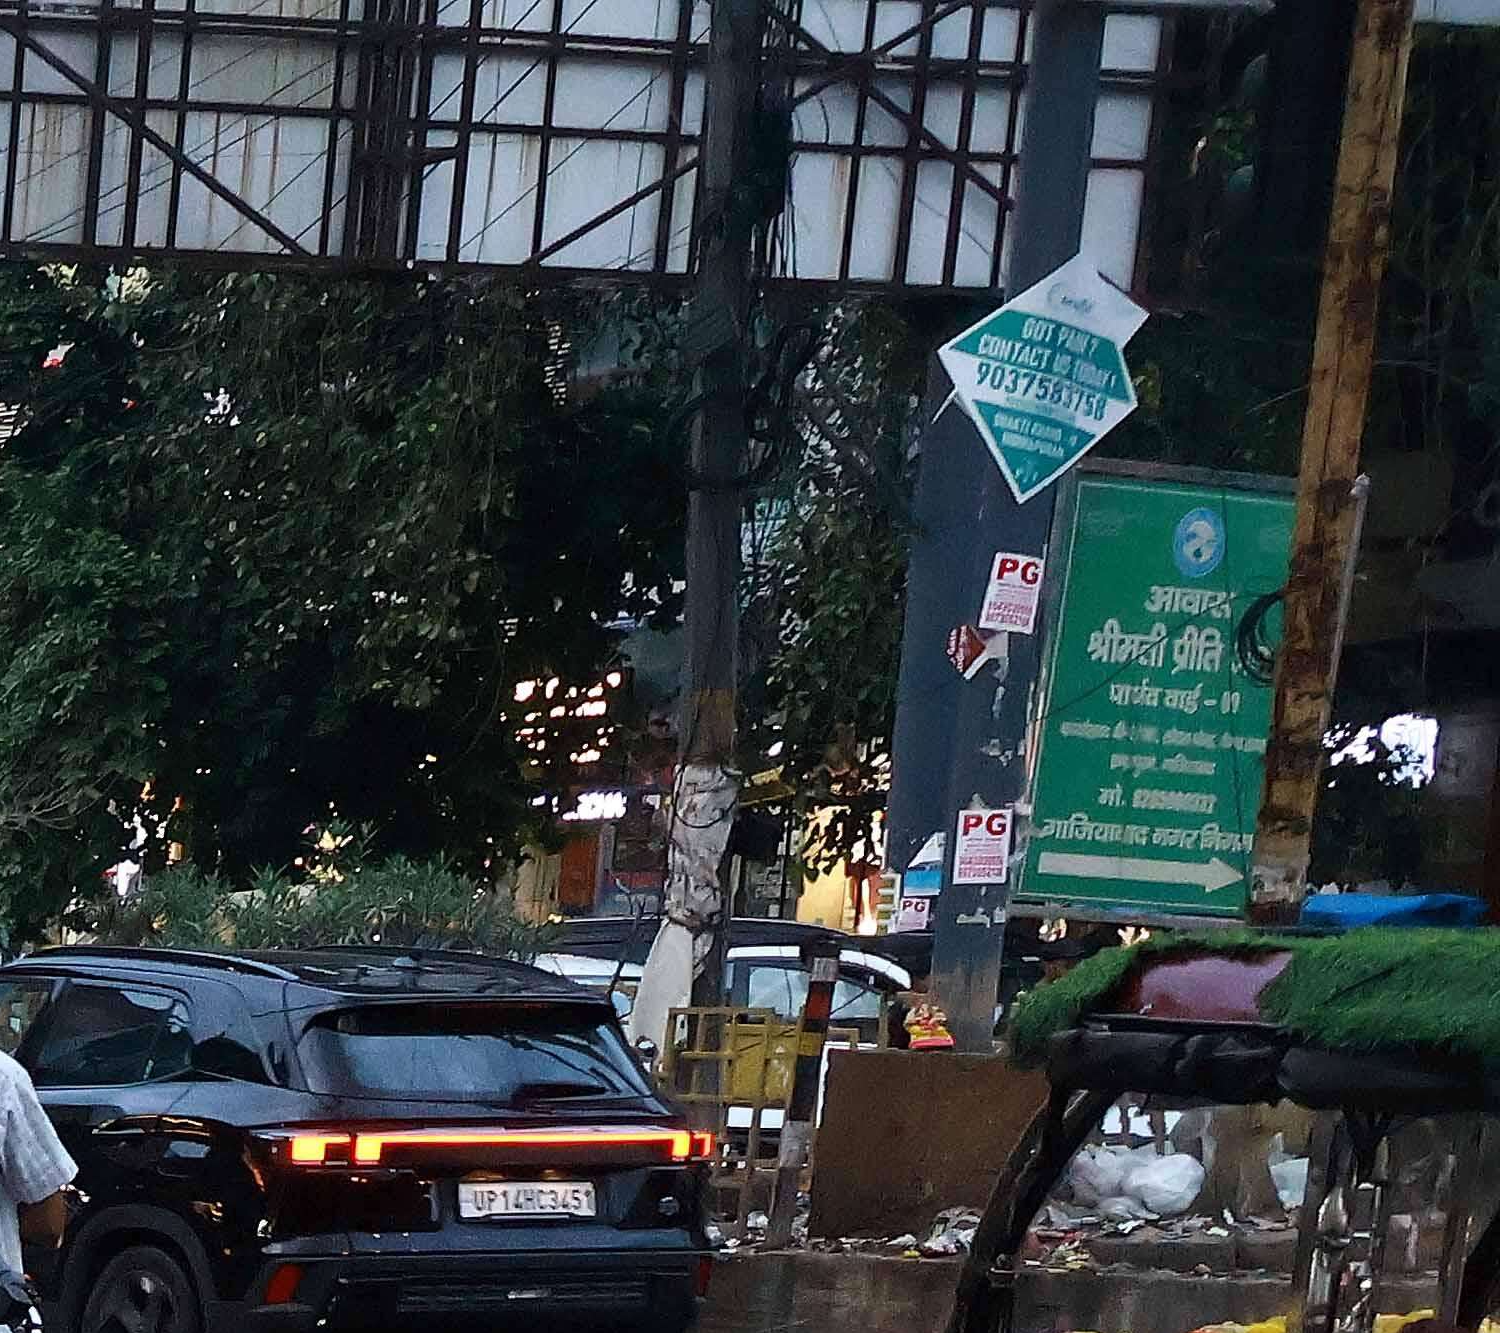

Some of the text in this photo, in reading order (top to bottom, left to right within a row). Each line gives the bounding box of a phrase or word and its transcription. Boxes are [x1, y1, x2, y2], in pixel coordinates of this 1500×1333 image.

[978, 334, 1053, 370] CONTACT
[996, 559, 1040, 585] PG
[962, 813, 1007, 837] PG
[902, 900, 926, 913] PG
